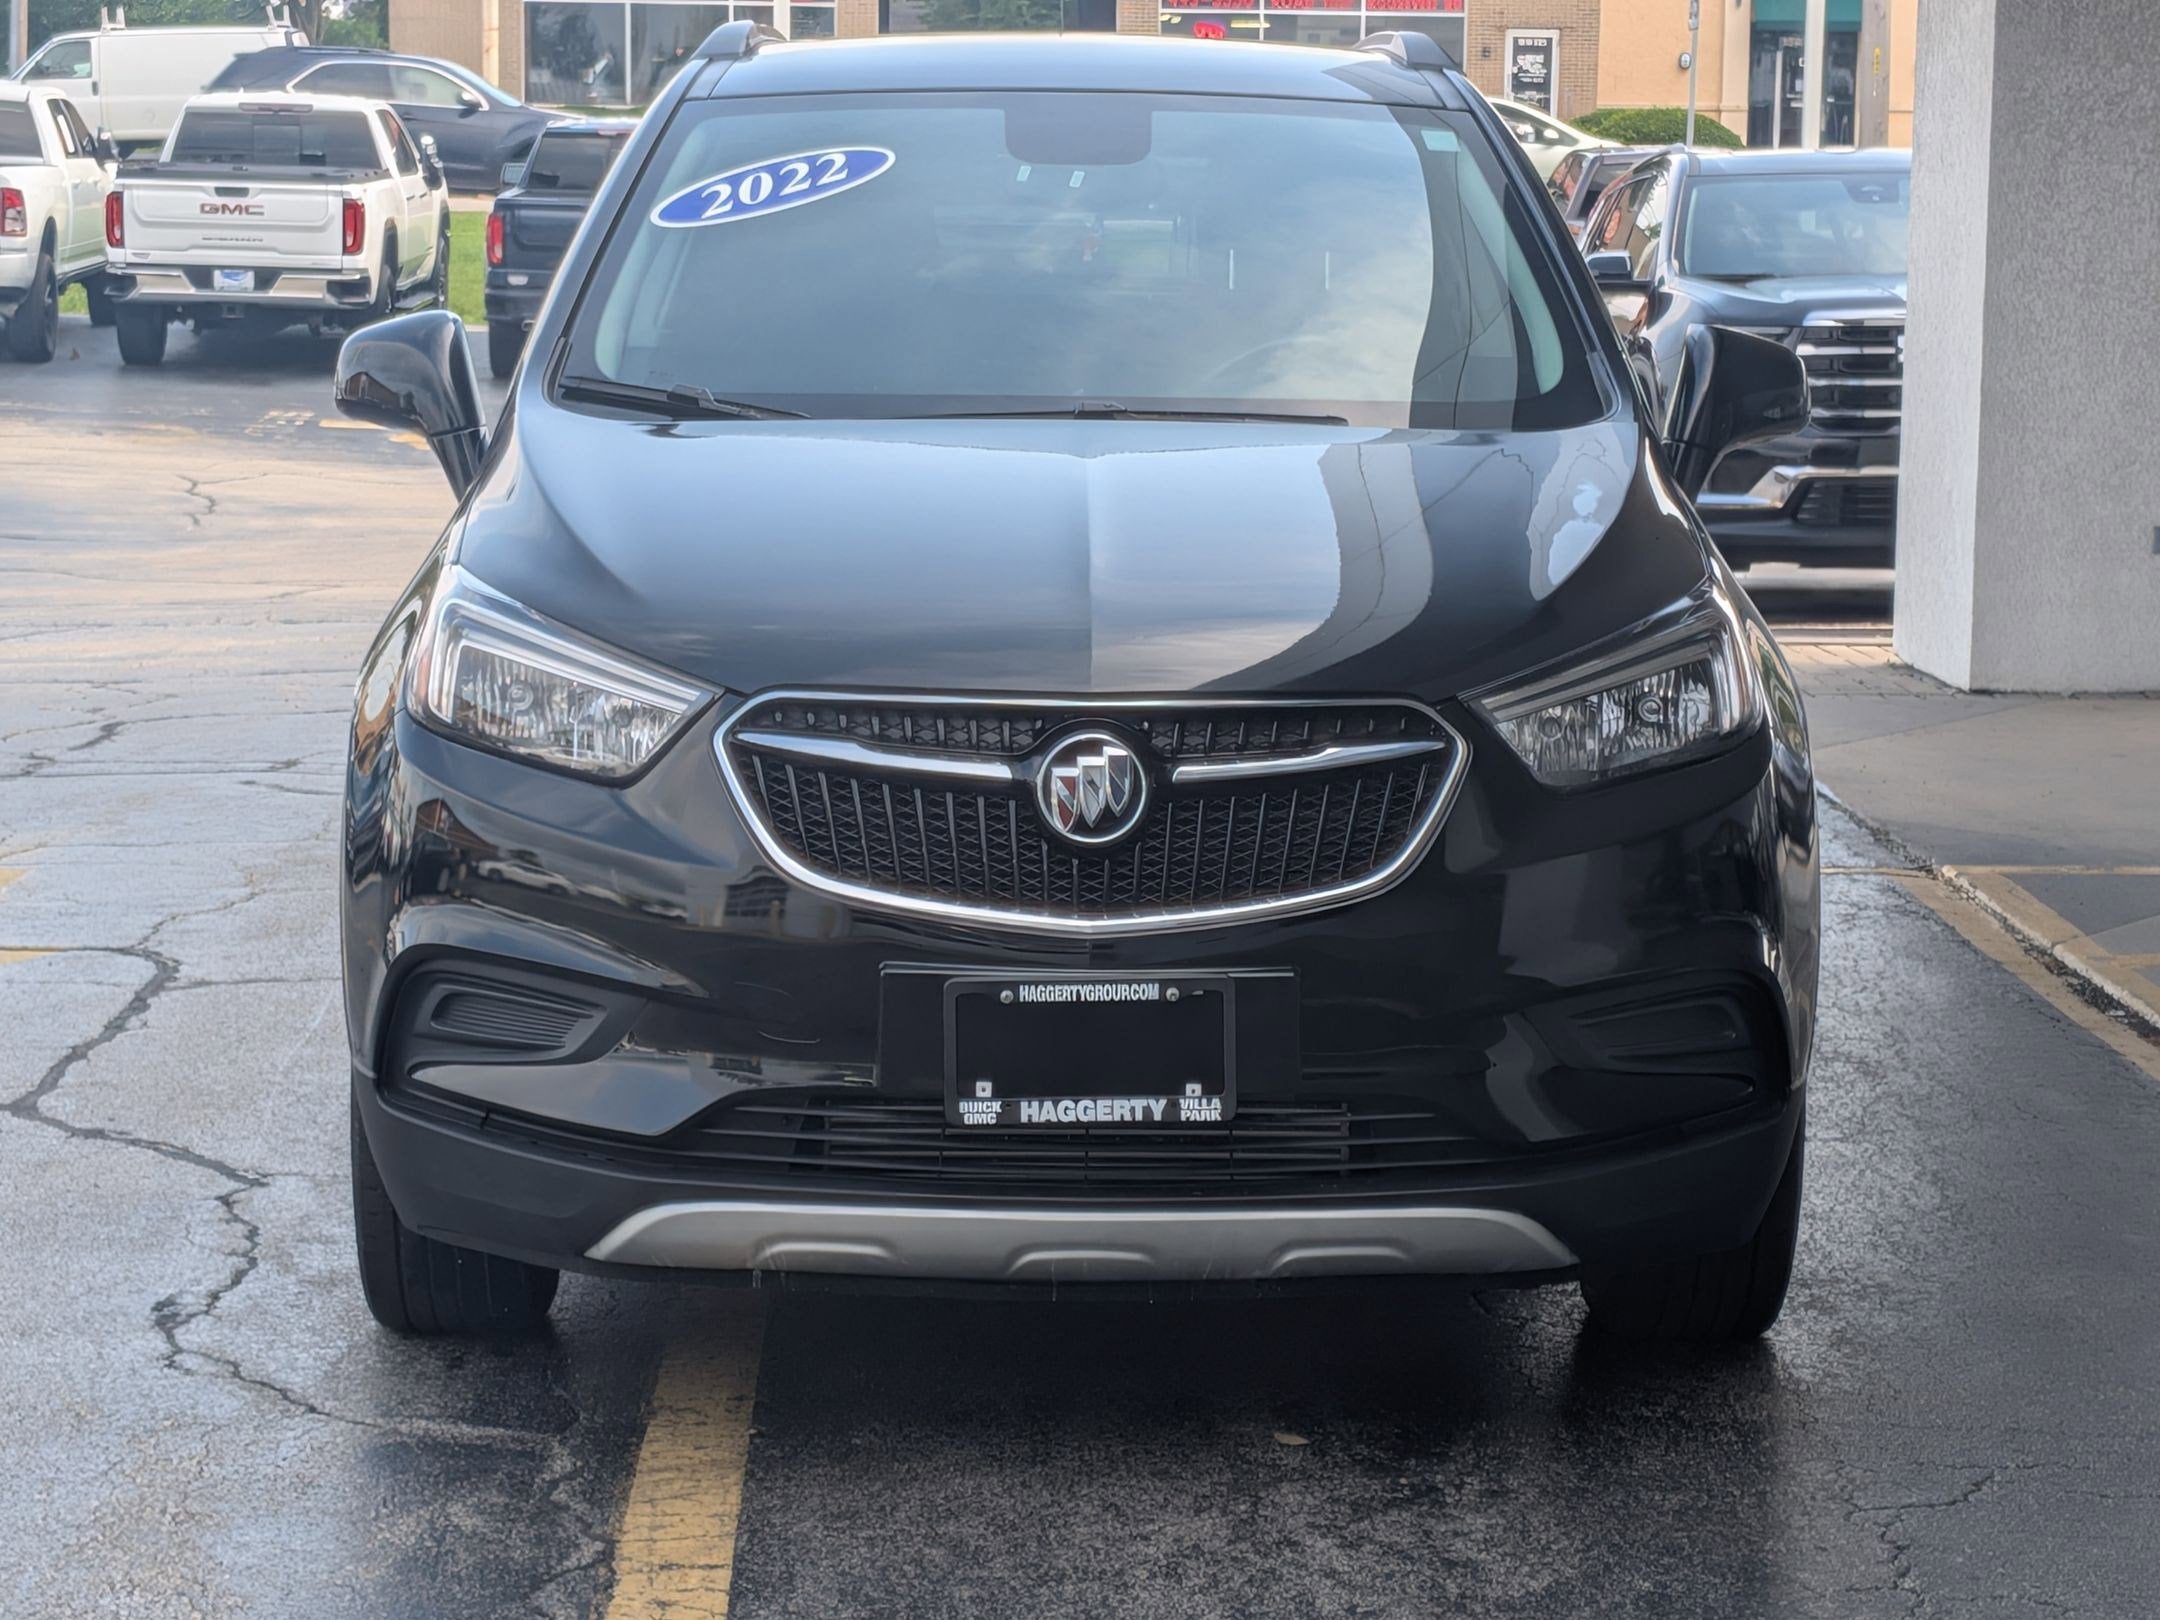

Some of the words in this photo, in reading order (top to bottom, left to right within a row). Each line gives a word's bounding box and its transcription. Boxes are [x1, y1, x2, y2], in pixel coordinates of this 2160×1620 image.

[701, 152, 849, 219] 2022
[200, 203, 265, 216] GMC
[959, 1101, 1002, 1113] BUICK
[1180, 1098, 1222, 1110] VILLA
[1020, 1099, 1168, 1123] HAGGERTY
[1180, 1109, 1222, 1121] PARK
